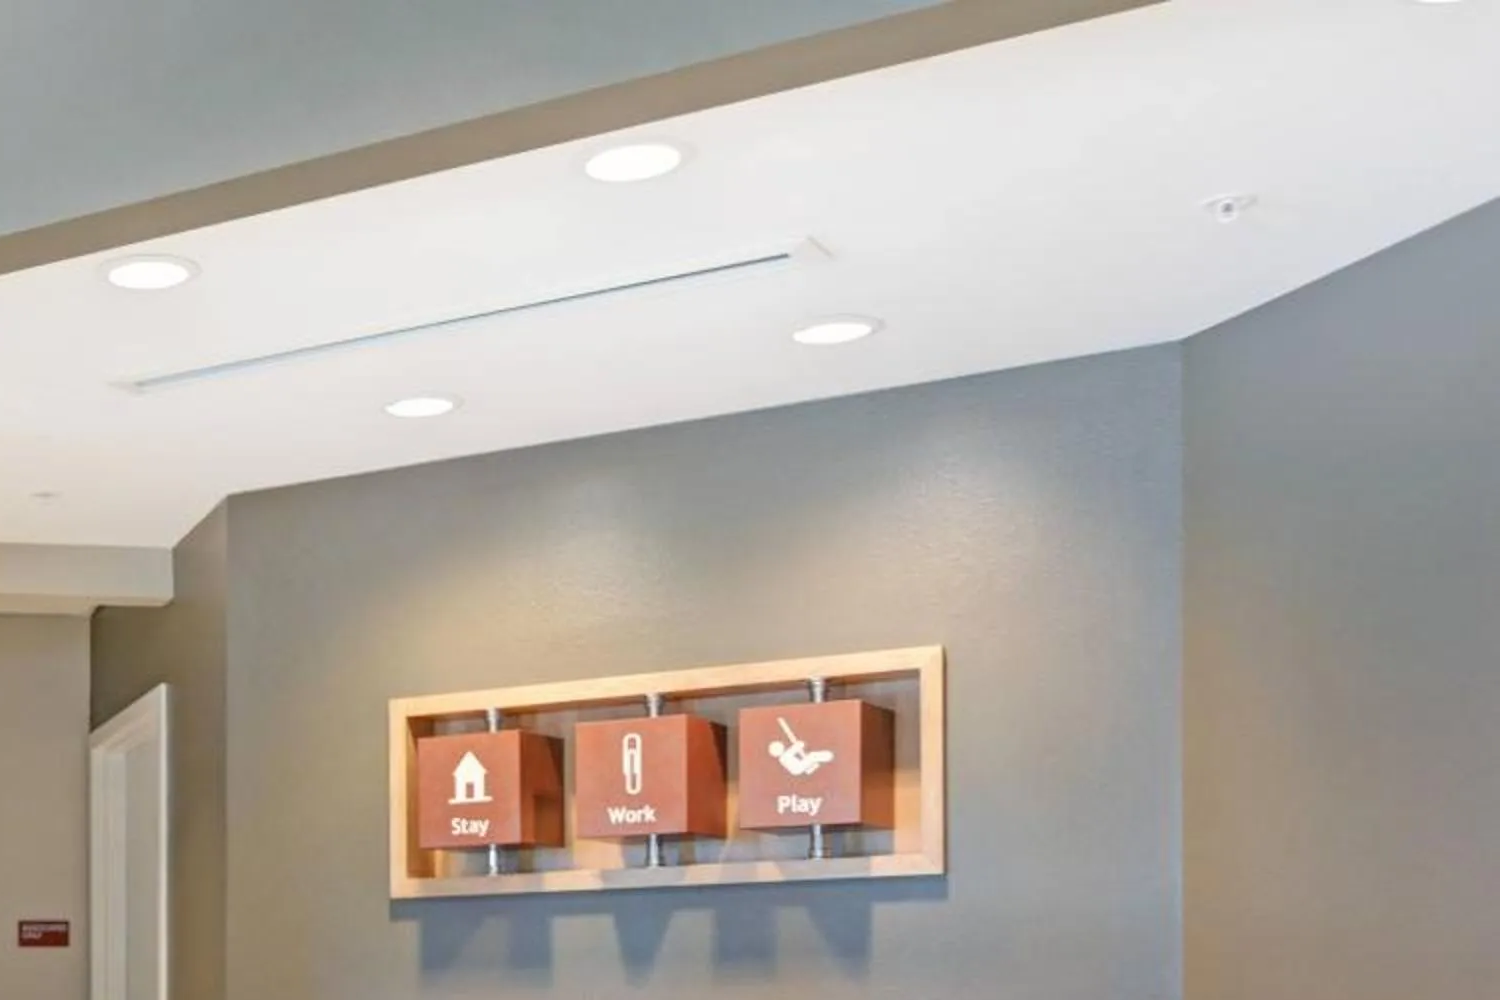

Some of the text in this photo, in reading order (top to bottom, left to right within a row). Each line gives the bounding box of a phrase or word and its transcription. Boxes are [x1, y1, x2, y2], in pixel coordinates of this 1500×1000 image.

[606, 804, 657, 825] Work
[777, 793, 824, 817] Play
[451, 817, 490, 838] Stay
